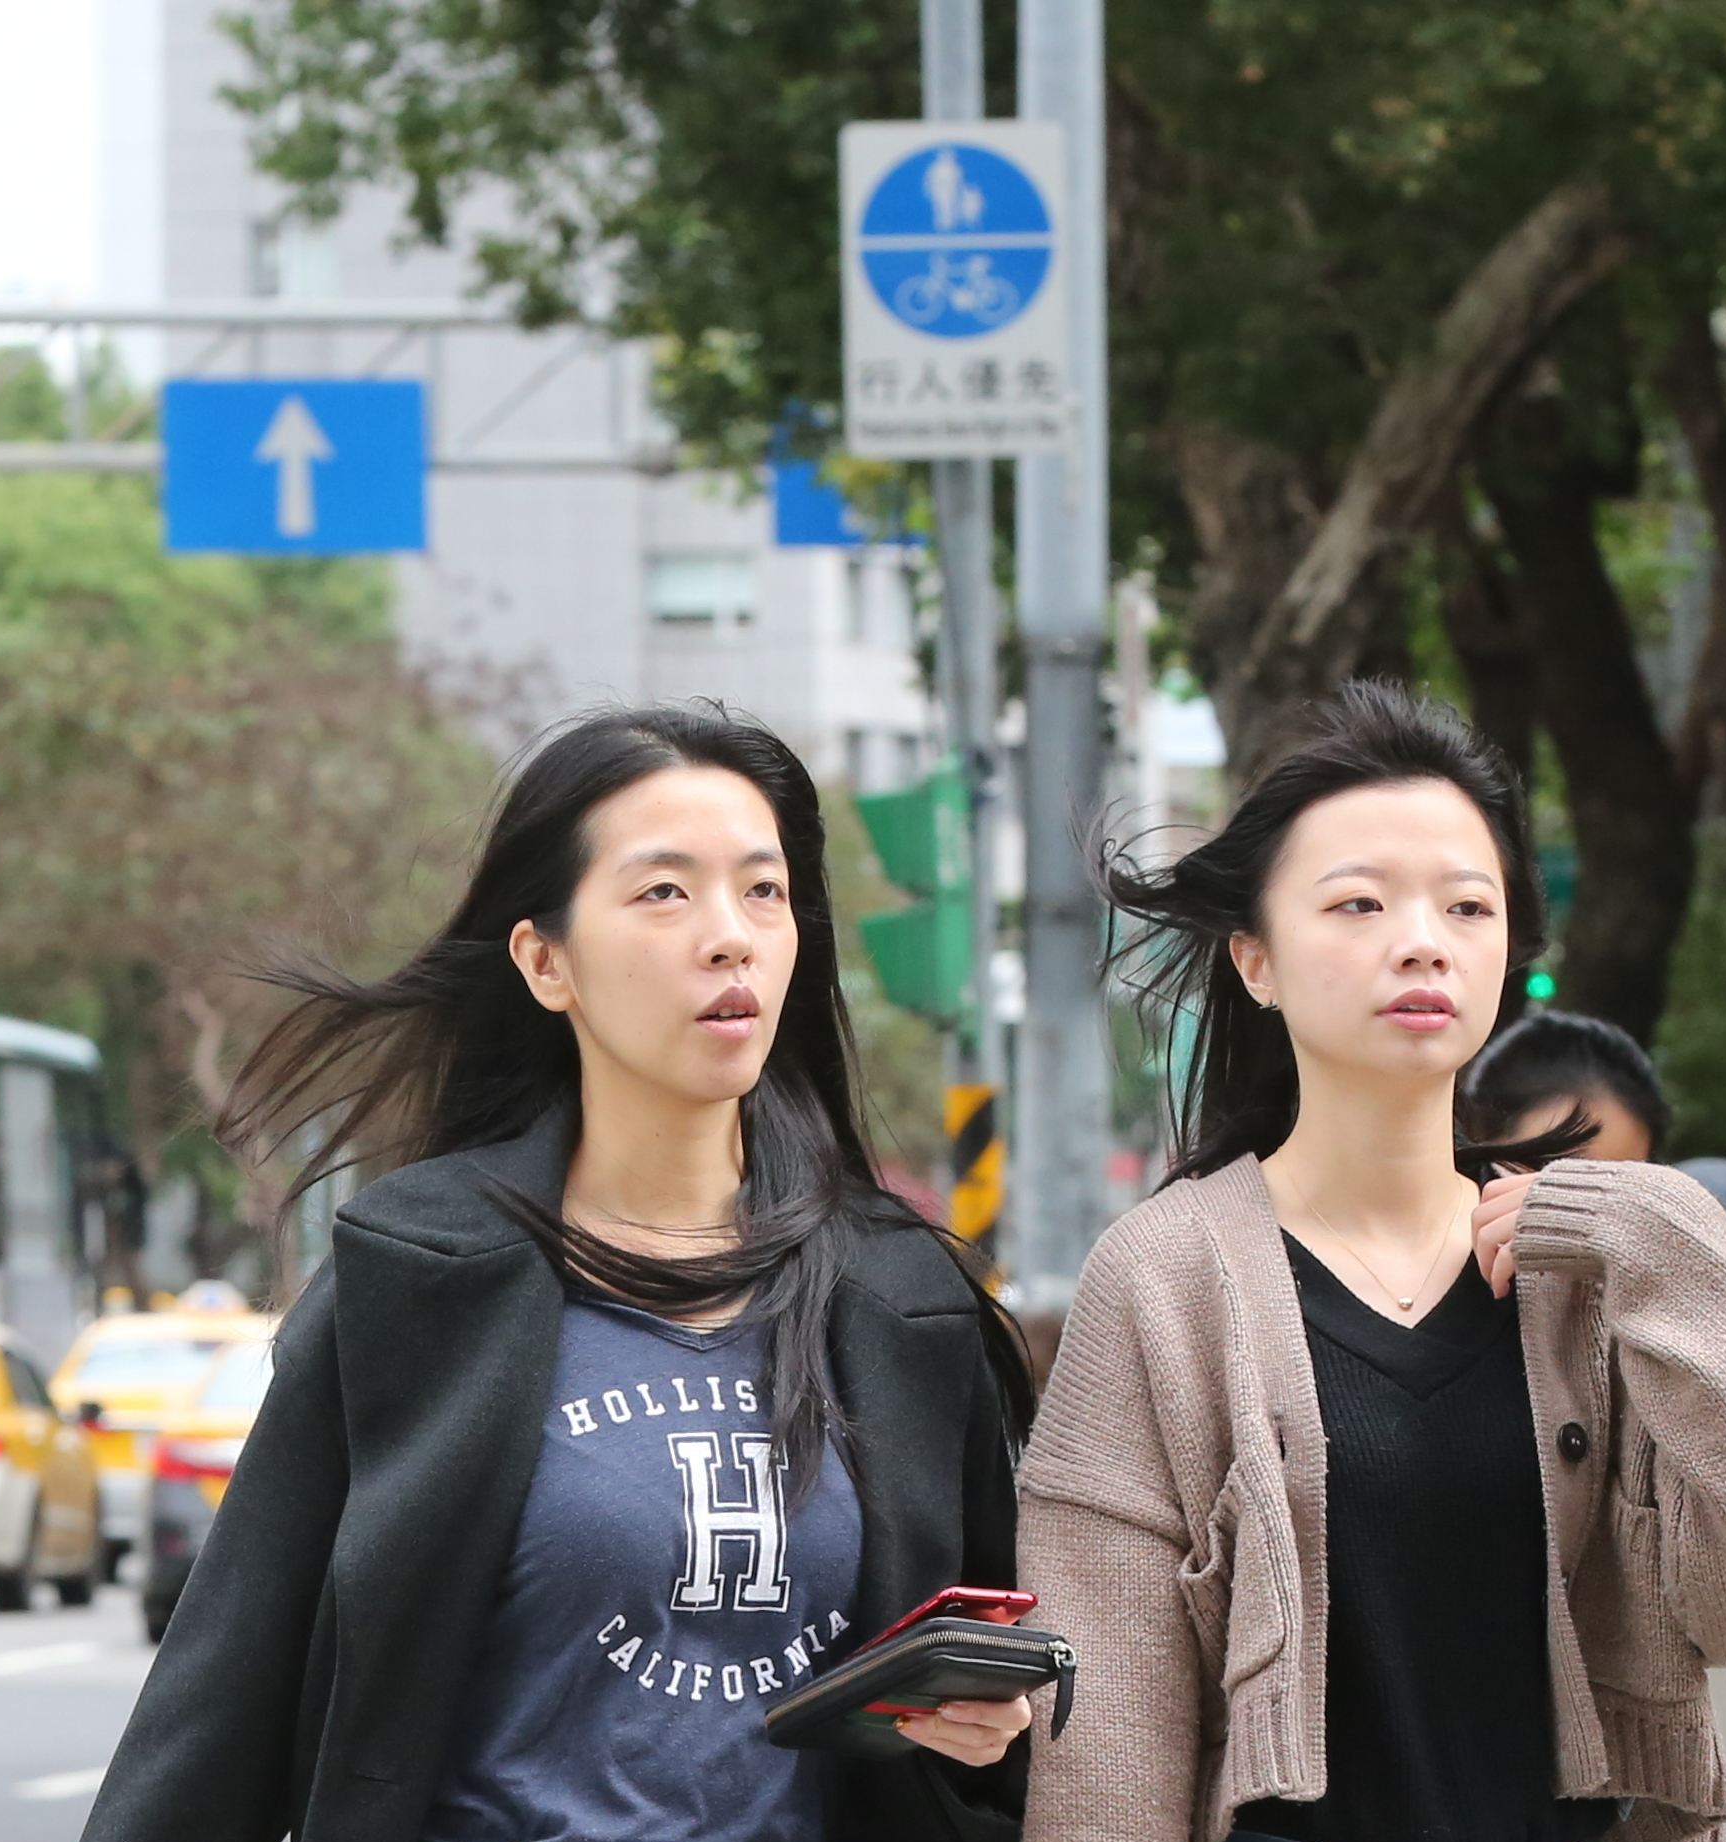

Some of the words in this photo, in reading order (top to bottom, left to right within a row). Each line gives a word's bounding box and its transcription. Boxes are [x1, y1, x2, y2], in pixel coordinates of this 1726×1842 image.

[560, 1376, 761, 1438] HOLLIS
[666, 1431, 792, 1614] H
[595, 1608, 851, 1703] CALIFORNIA
